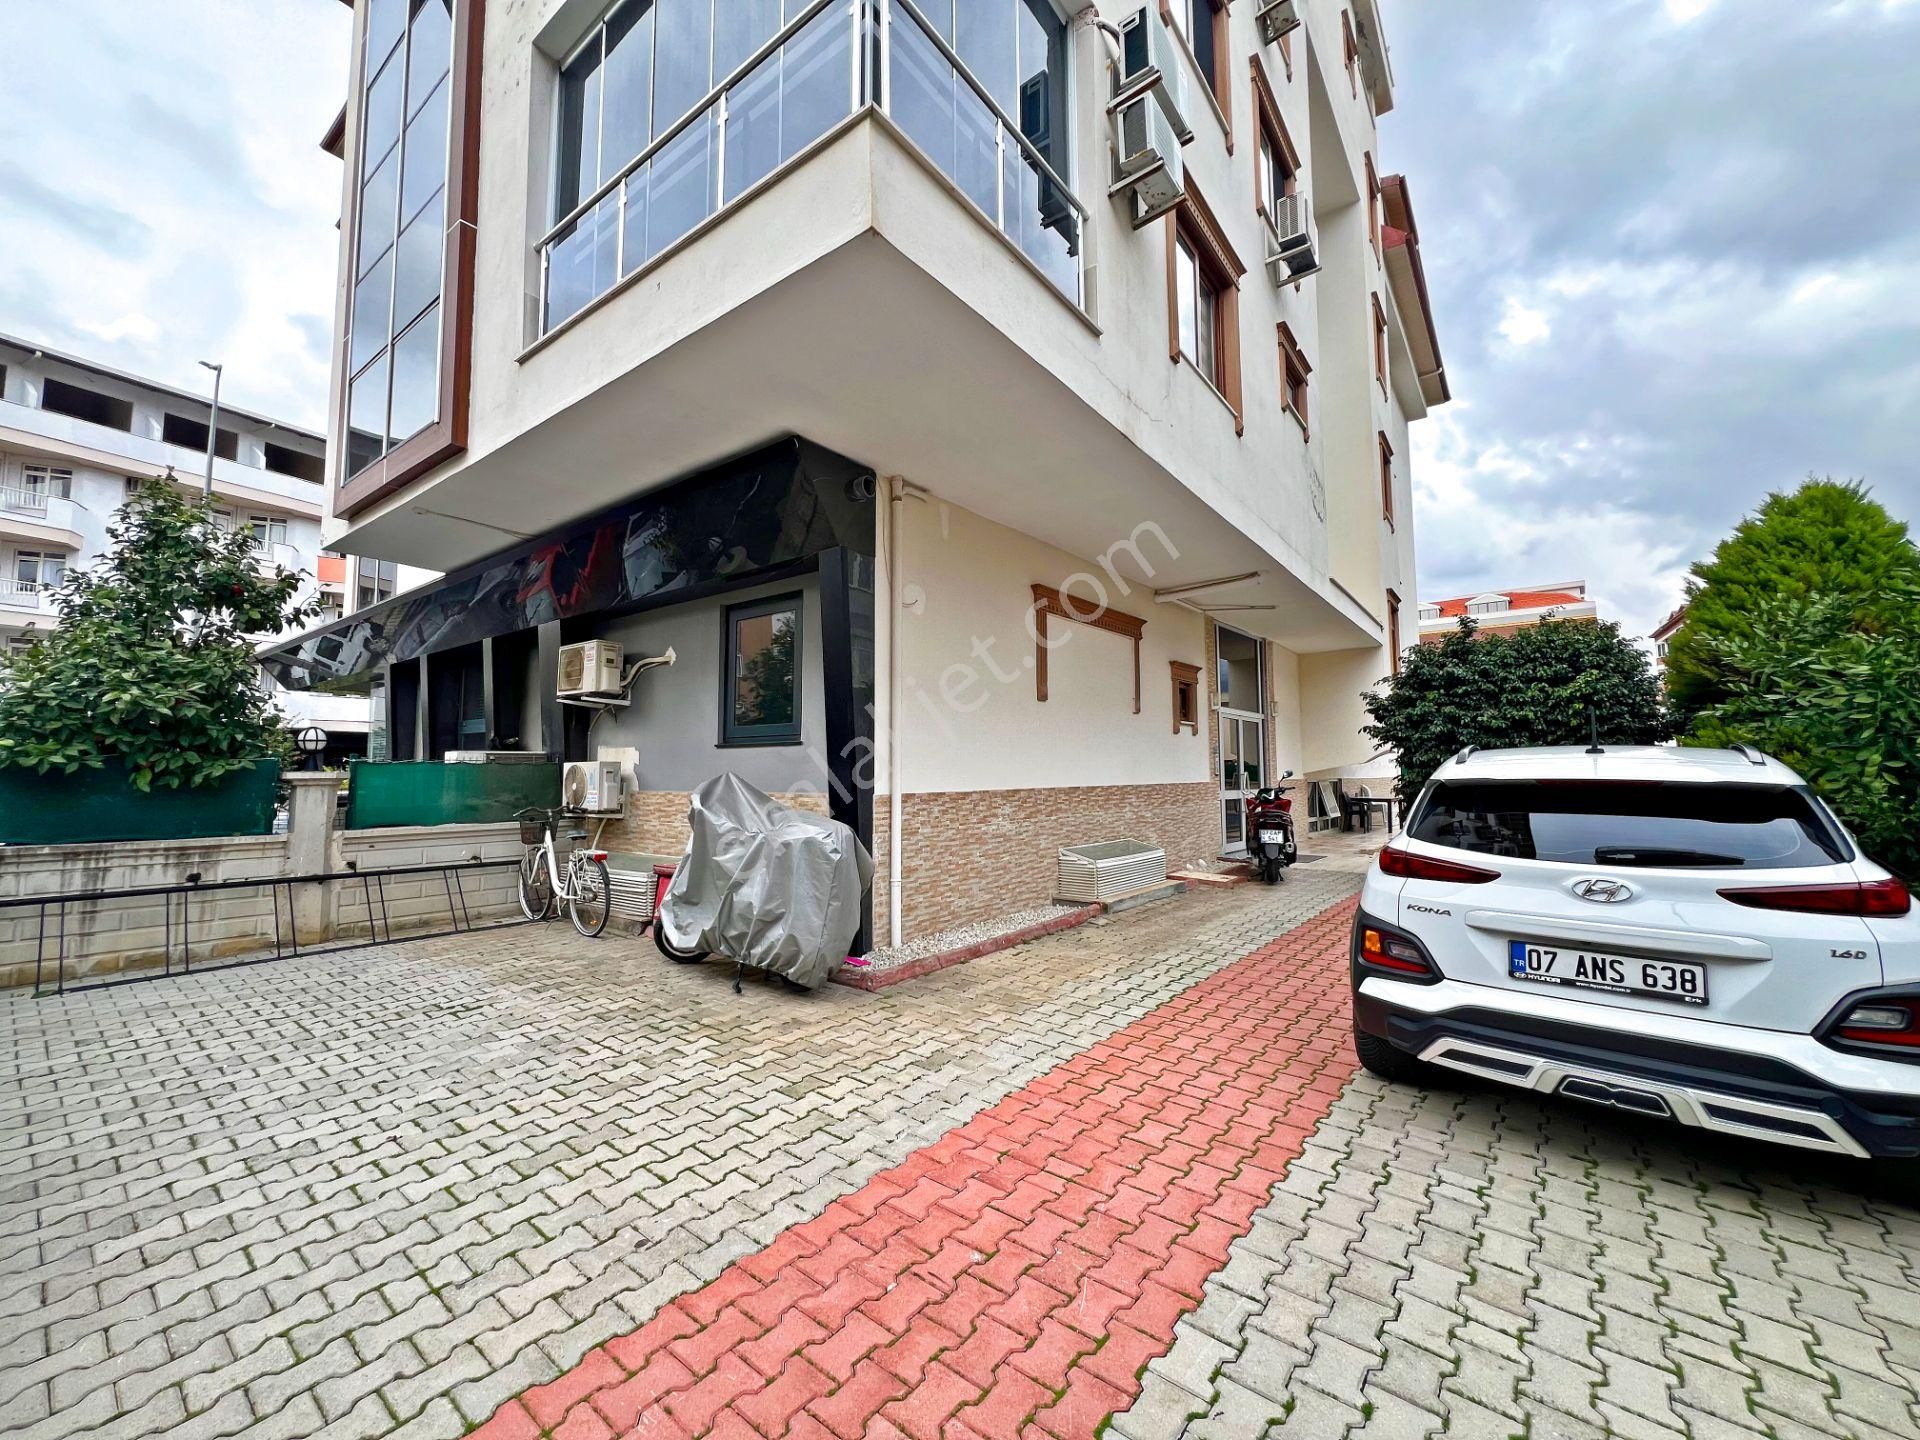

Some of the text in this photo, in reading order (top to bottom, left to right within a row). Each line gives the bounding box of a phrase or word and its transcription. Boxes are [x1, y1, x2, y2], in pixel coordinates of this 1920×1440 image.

[1407, 903, 1452, 917] KONA
[1514, 959, 1526, 967] TR
[1527, 948, 1698, 995] 07 ANS 638
[1527, 974, 1561, 984] HYUNDAI
